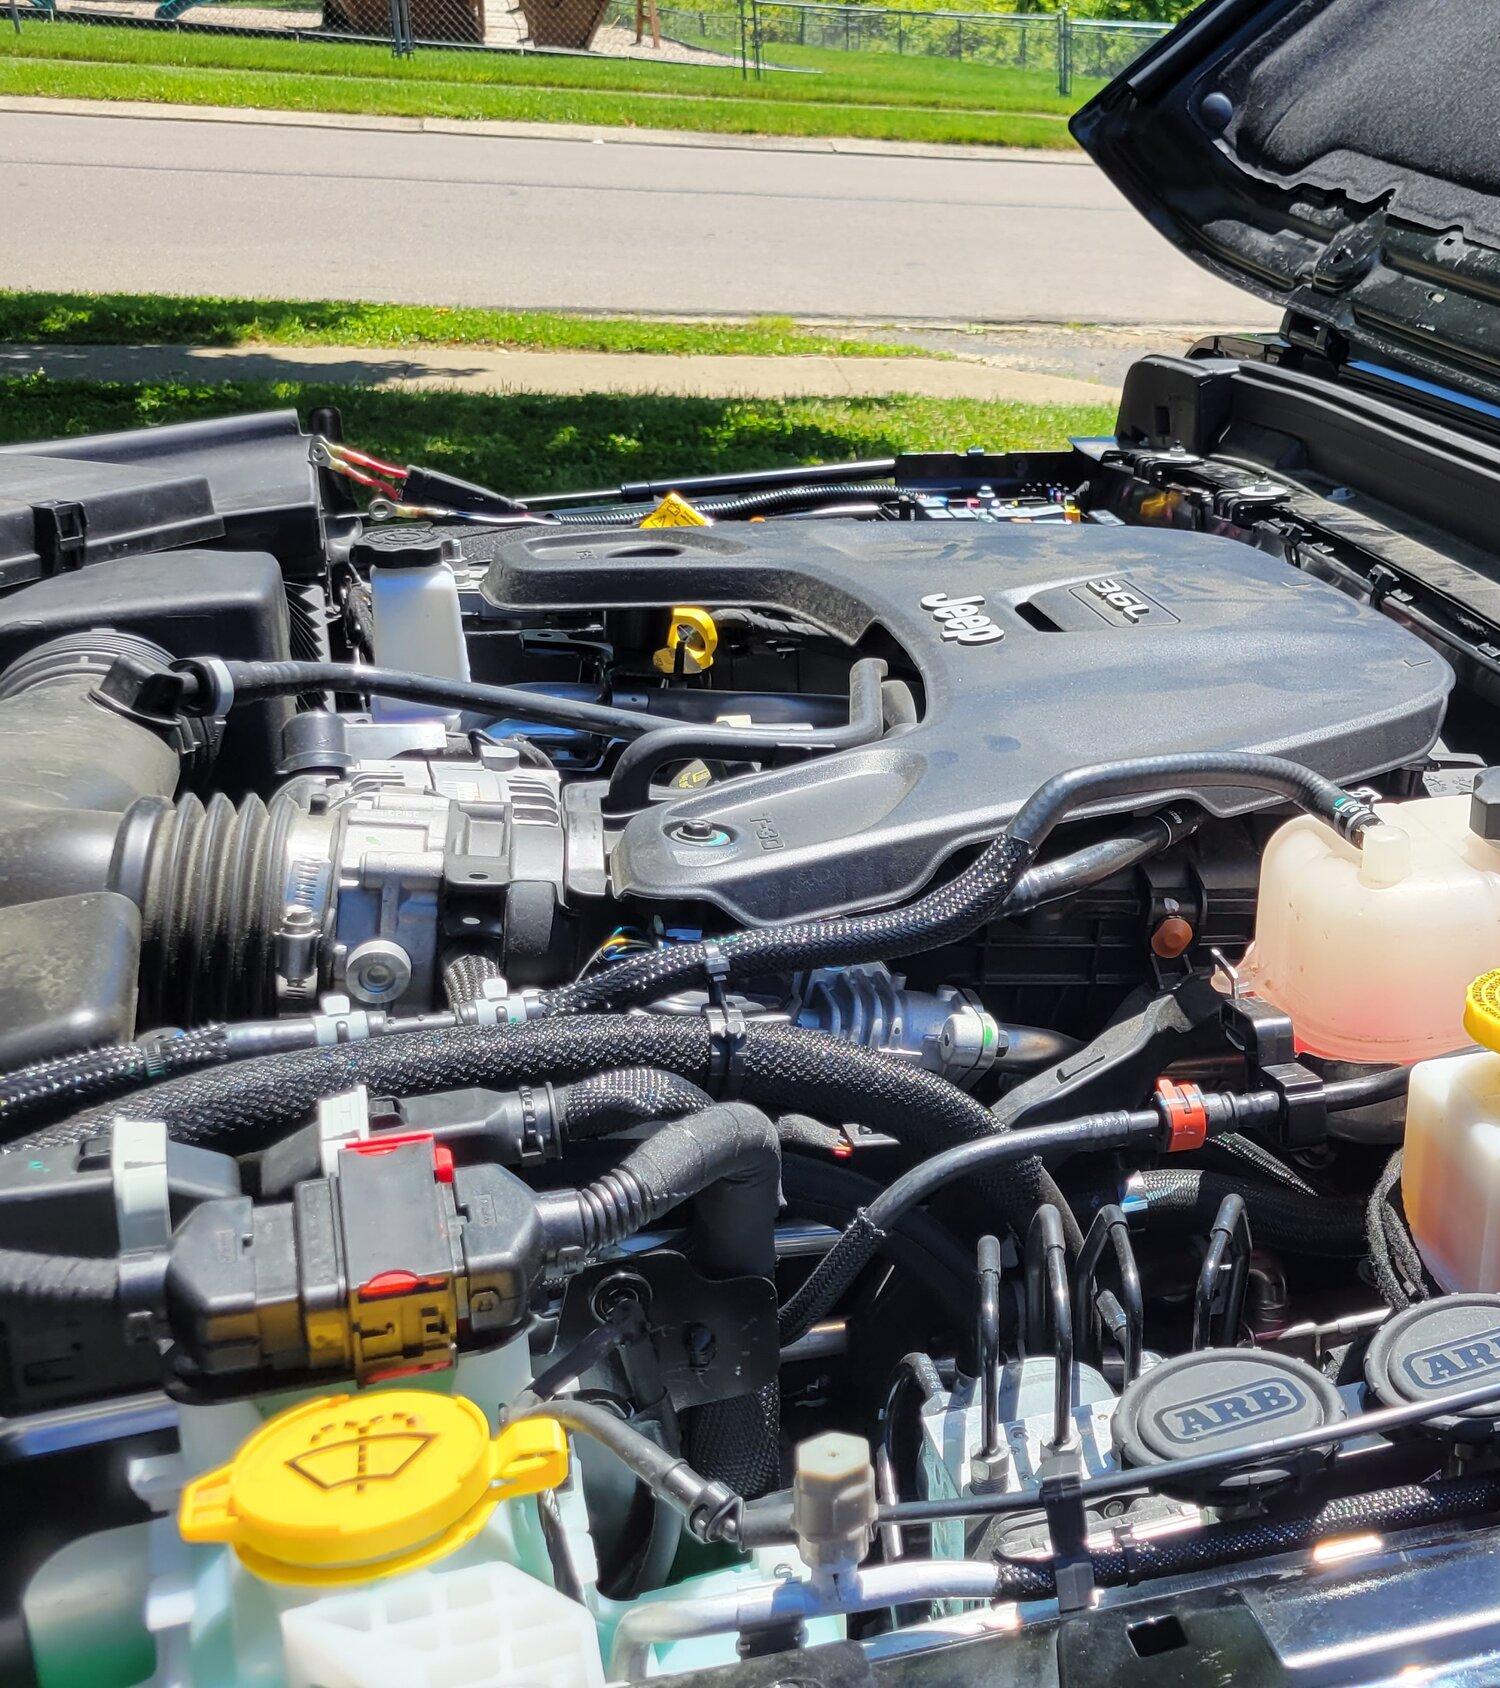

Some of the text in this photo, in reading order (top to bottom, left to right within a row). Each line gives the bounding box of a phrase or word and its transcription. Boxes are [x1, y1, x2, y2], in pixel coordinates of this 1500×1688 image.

[920, 592, 1005, 646] Jeep
[1086, 579, 1150, 624] 3.6L
[1174, 1386, 1292, 1436] ARB
